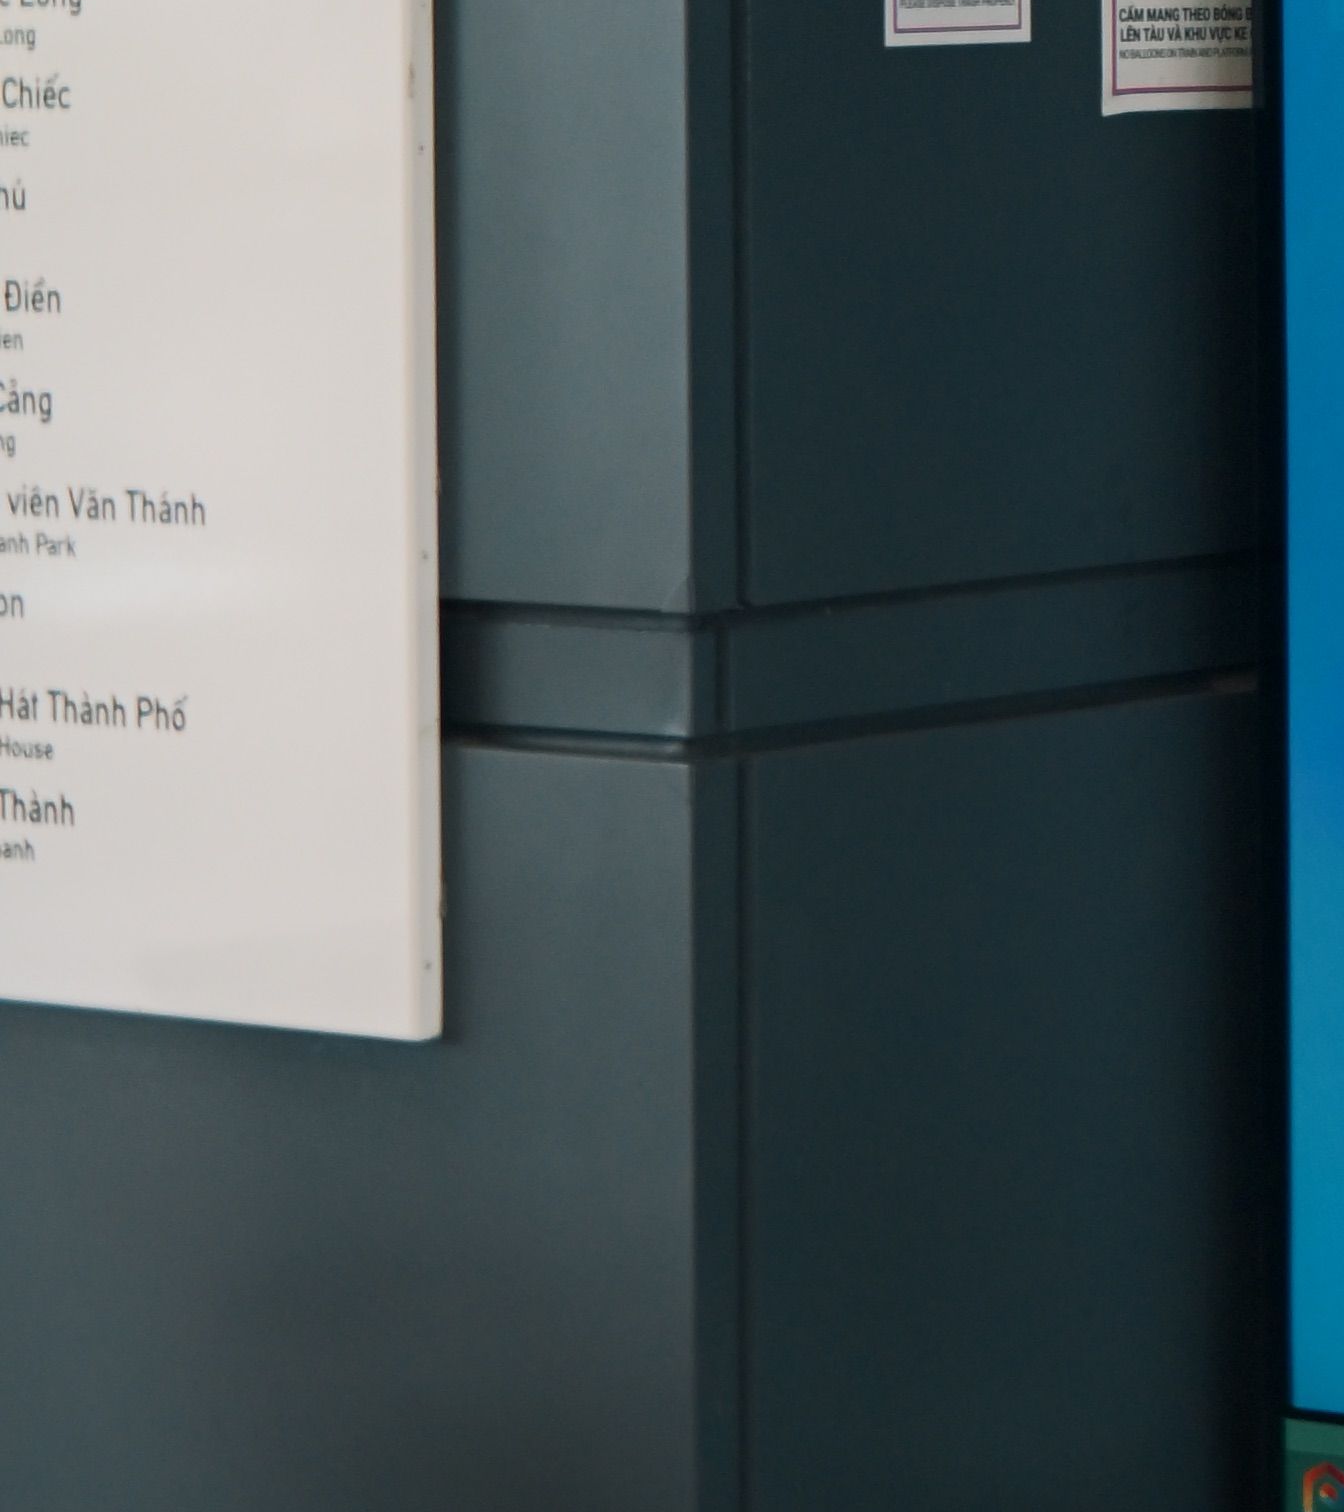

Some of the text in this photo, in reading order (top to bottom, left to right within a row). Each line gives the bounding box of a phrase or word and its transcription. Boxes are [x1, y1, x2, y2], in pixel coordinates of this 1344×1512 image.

[1119, 5, 1144, 23] CẤM
[1146, 7, 1180, 22] MANG
[1182, 7, 1211, 22] THEO
[0, 27, 36, 51] ong
[1120, 24, 1141, 42] LÊN
[1144, 24, 1165, 42] TÀU
[1167, 24, 1182, 41] VÀ
[1184, 27, 1207, 41] KHU
[2, 74, 71, 110] Chiếc
[7, 483, 206, 527] viên Văn Thánh
[36, 532, 77, 558] Park
[48, 689, 127, 728] Thành
[136, 694, 189, 732] Phố
[0, 735, 54, 761] House
